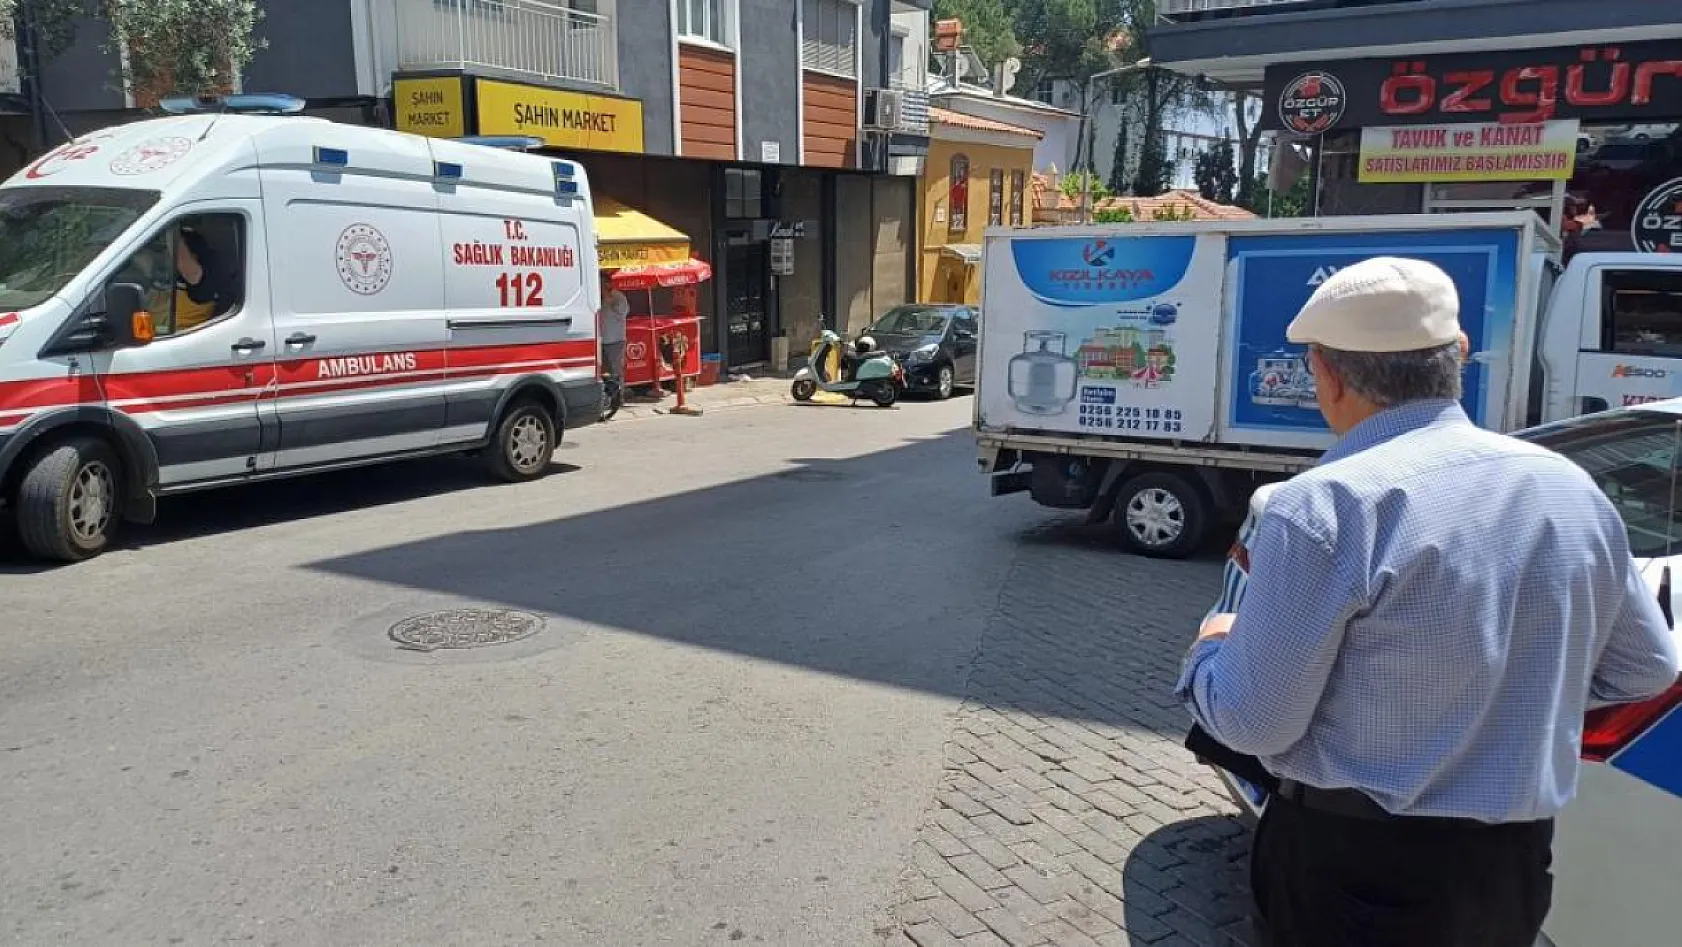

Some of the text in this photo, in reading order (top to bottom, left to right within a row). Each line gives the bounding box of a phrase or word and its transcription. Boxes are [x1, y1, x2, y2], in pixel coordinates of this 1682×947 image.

[1379, 46, 1682, 124] özgür
[408, 110, 450, 126] MARKET
[513, 101, 616, 132] ŞAHİN MARKET
[1391, 126, 1545, 149] TAVUK ve KANAT
[503, 220, 528, 241] T.C.
[453, 238, 574, 267] SAĞLIK BAKANLIĞI
[495, 272, 544, 307] 112
[317, 352, 417, 378] AMBULANS
[1116, 419, 1140, 429] 212
[1146, 421, 1159, 430] 17
